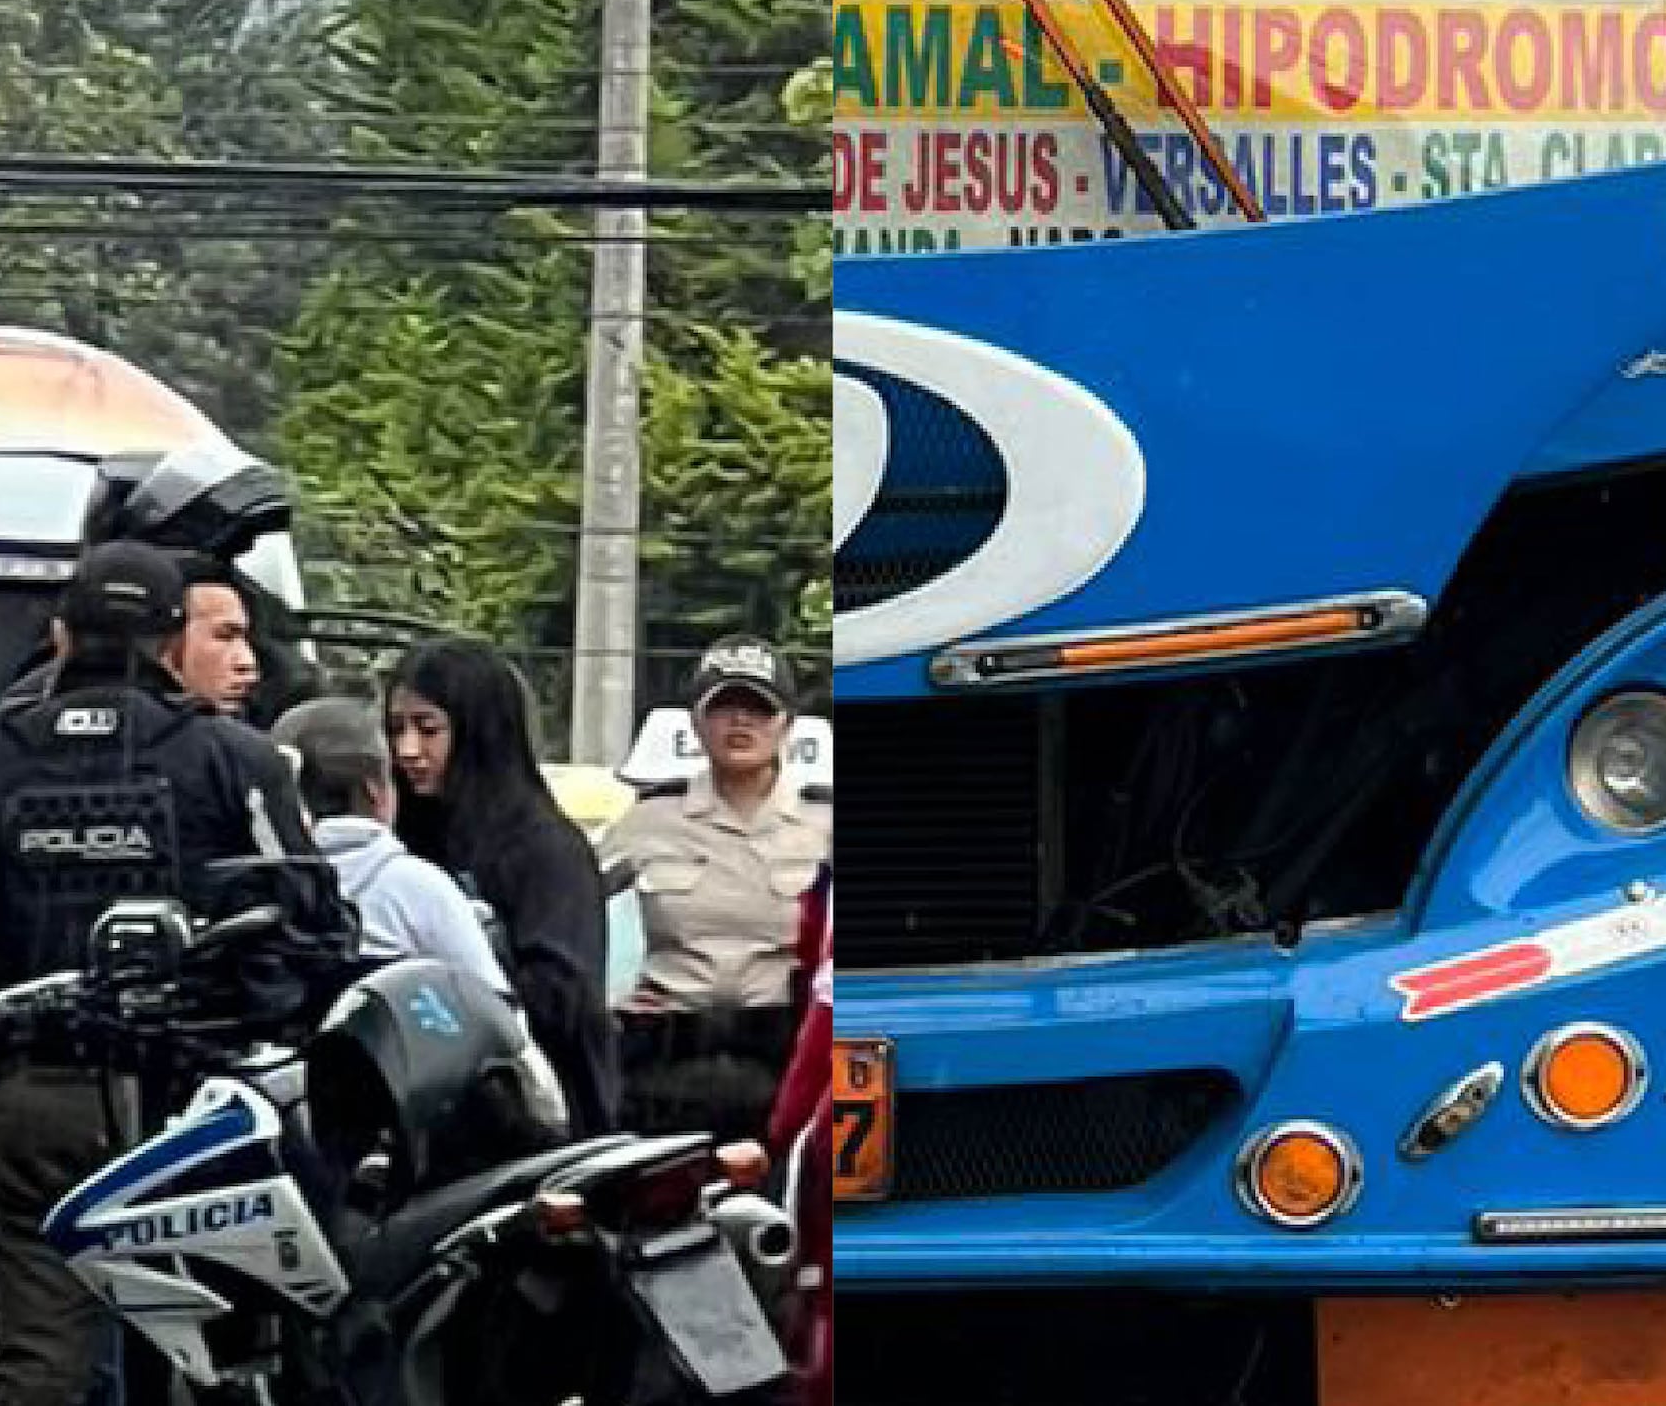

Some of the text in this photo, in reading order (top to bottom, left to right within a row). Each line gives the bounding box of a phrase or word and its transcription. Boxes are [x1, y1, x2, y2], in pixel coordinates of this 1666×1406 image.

[833, 4, 1070, 108] AMAL
[833, 131, 888, 213] DE
[903, 130, 1060, 214] JESUS
[1101, 131, 1376, 215] VERSALLES
